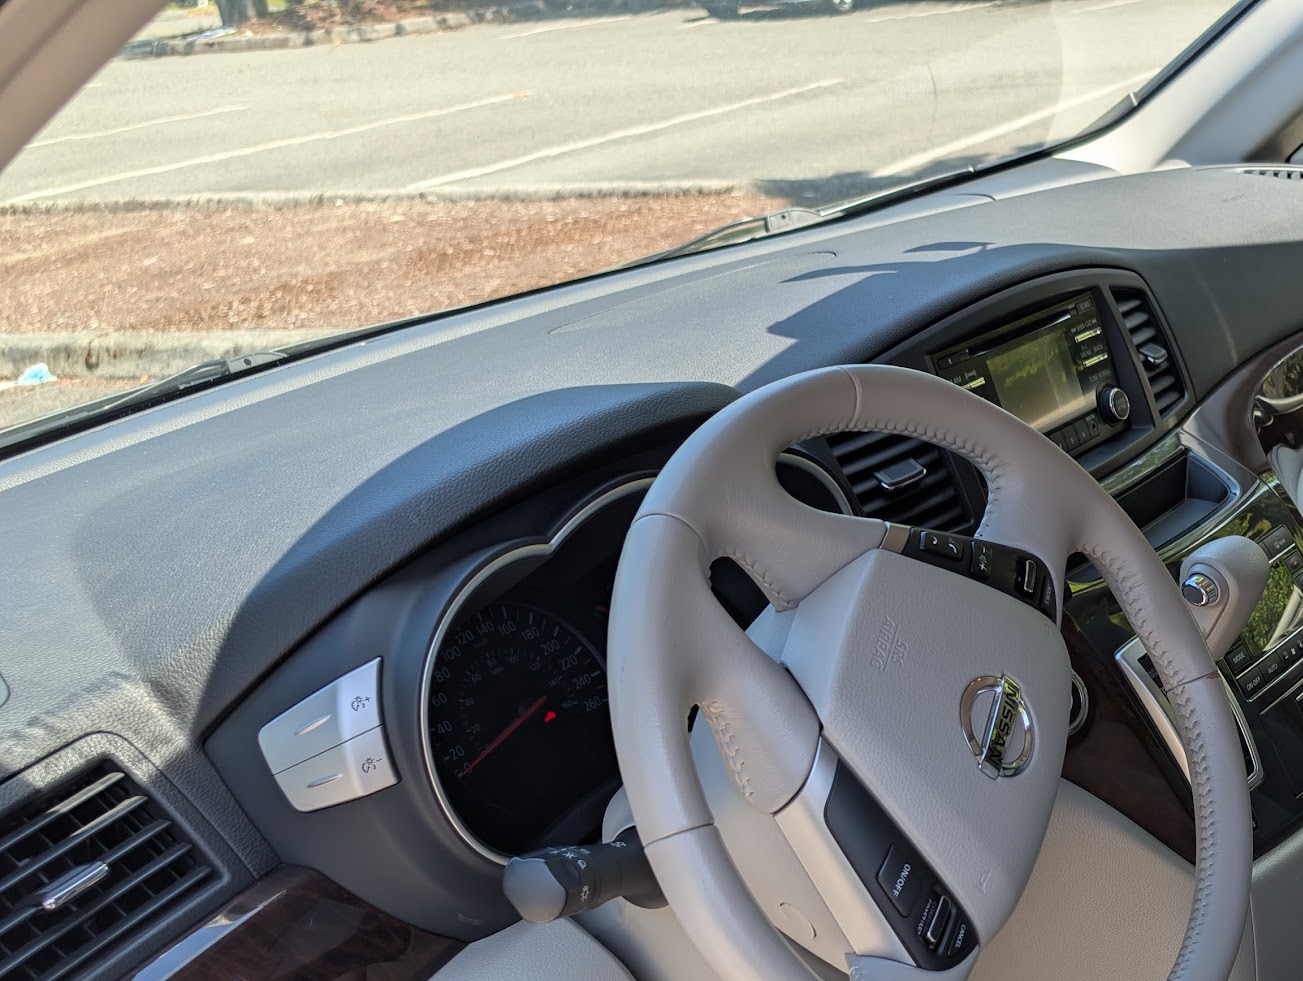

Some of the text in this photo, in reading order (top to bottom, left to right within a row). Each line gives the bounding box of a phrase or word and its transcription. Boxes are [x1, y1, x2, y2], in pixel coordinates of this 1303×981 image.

[476, 620, 495, 637] 140
[497, 620, 516, 636] 160
[521, 626, 540, 641] 180
[455, 630, 475, 647] 120
[870, 614, 896, 670] AIRBAG
[440, 646, 461, 661] 100
[541, 640, 560, 655] 200
[892, 639, 908, 667] SRS
[559, 655, 578, 671] 220
[1232, 651, 1246, 663] MODE
[434, 667, 451, 682] 80
[1267, 663, 1278, 674] AUTO
[573, 673, 592, 689] 240
[431, 692, 448, 707] 60
[583, 695, 603, 712] 260
[437, 721, 453, 734] 40
[987, 683, 1020, 767] NISSAN
[448, 745, 465, 760] 20
[892, 863, 911, 897] ON/OFF
[955, 924, 967, 948] CANCEL
